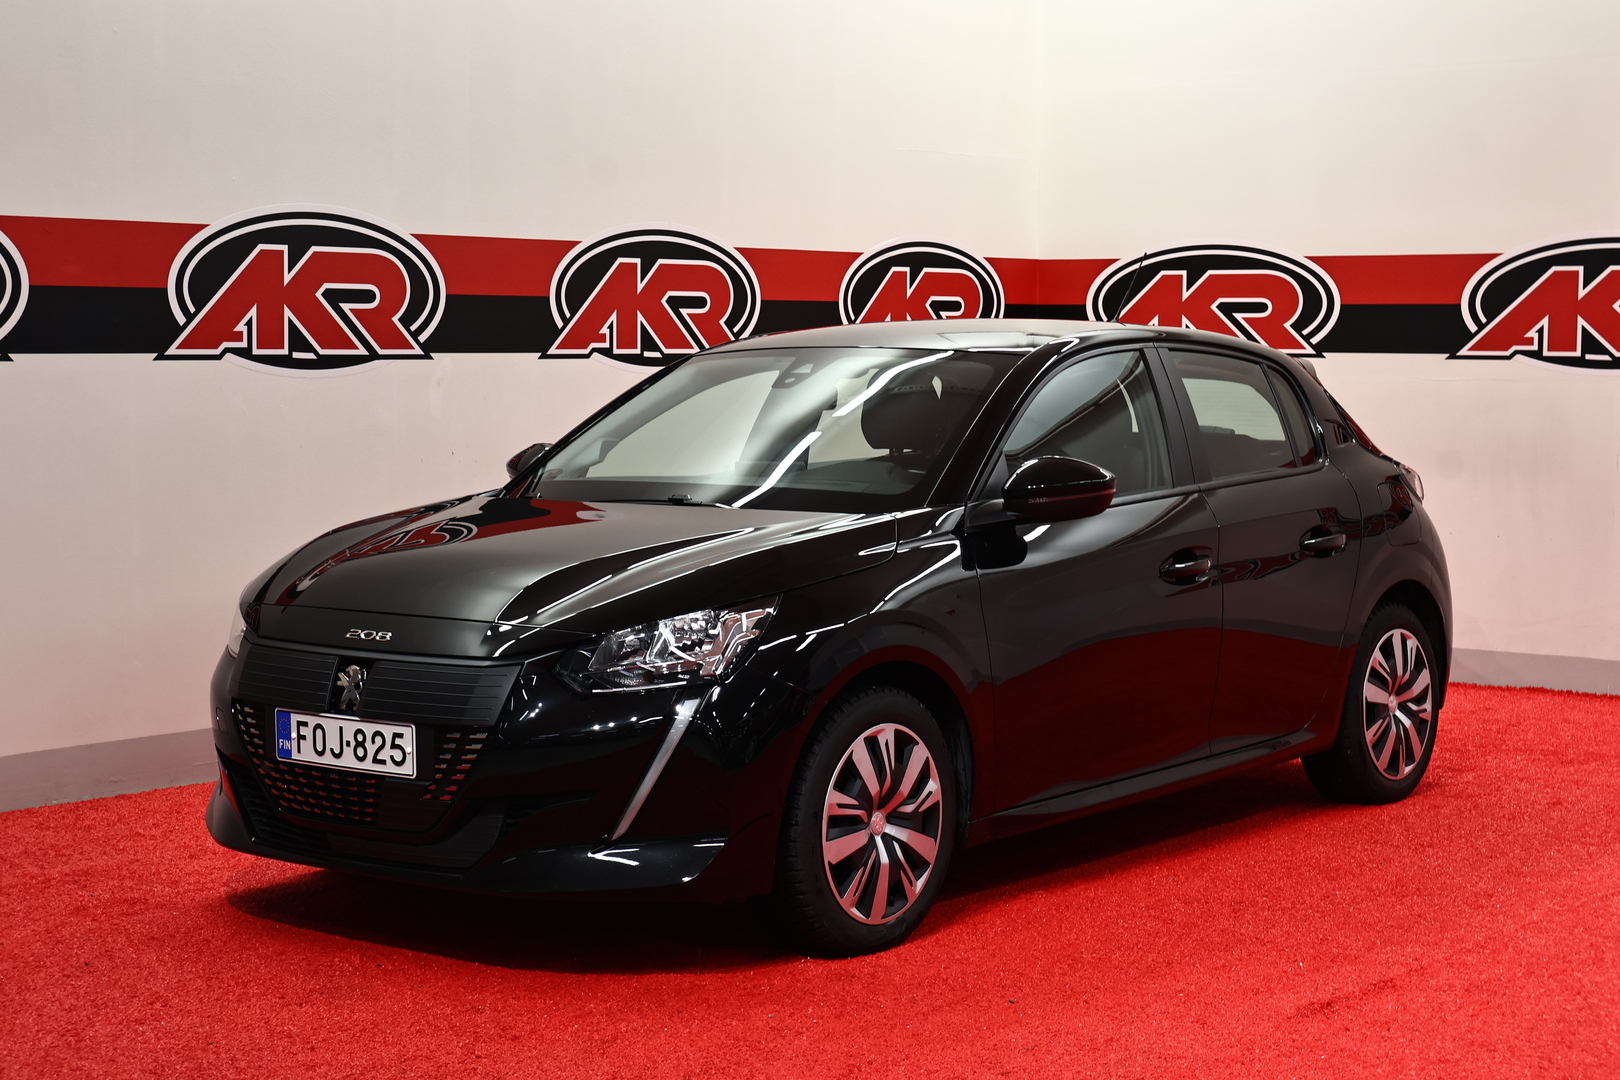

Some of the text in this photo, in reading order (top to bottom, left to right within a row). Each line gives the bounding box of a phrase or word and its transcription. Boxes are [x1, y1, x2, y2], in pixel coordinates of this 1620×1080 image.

[163, 243, 426, 356] AKR
[546, 257, 736, 355] AKR
[345, 628, 393, 642] 208
[279, 739, 291, 750] FIN
